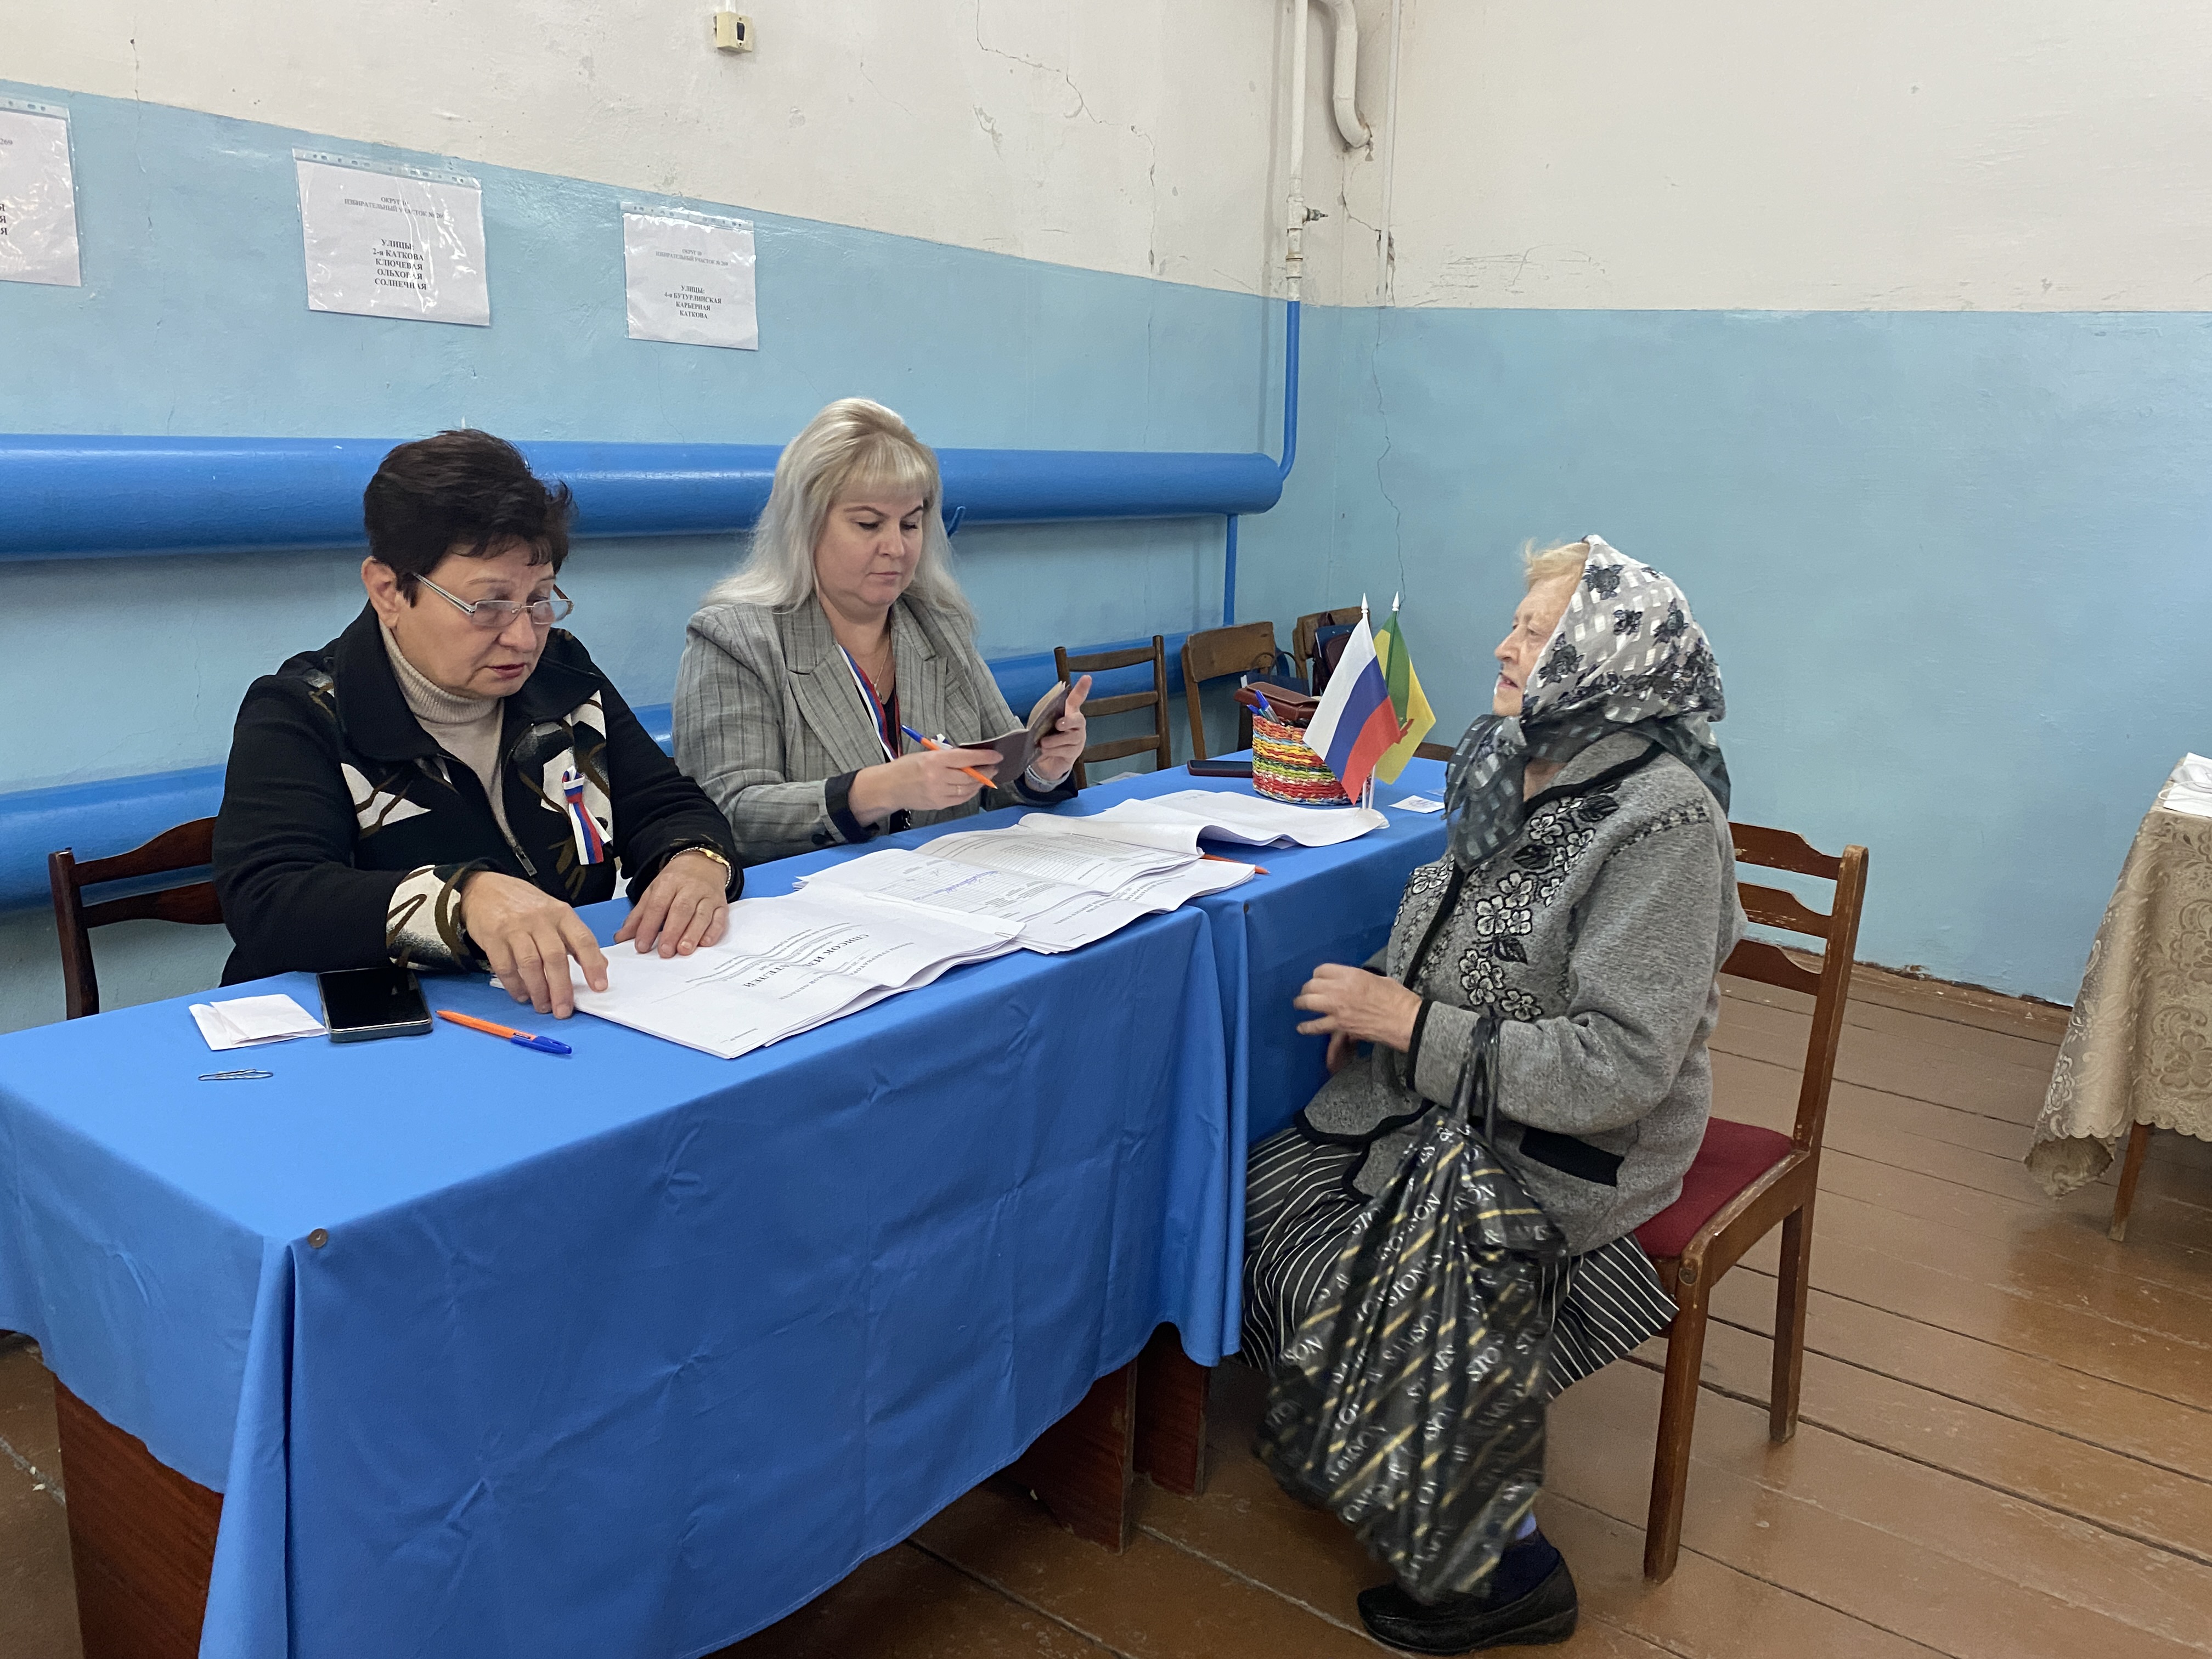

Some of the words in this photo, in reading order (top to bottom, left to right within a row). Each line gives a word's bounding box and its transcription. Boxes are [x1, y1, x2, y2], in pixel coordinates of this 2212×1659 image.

[345, 199, 397, 212] ИЗБИРАТЕЛЬНЫЙ
[386, 250, 424, 261] КАТКОВА
[376, 258, 422, 270] КЛЮЧЕВАЯ
[681, 285, 705, 294] УЛИЦЫ:
[674, 292, 721, 304] БУТУРЛИНСКАЯ
[676, 301, 710, 311] КАРЬЕРНАЯ
[680, 310, 708, 319] КАТКОВА
[823, 934, 869, 955] СПИСОК
